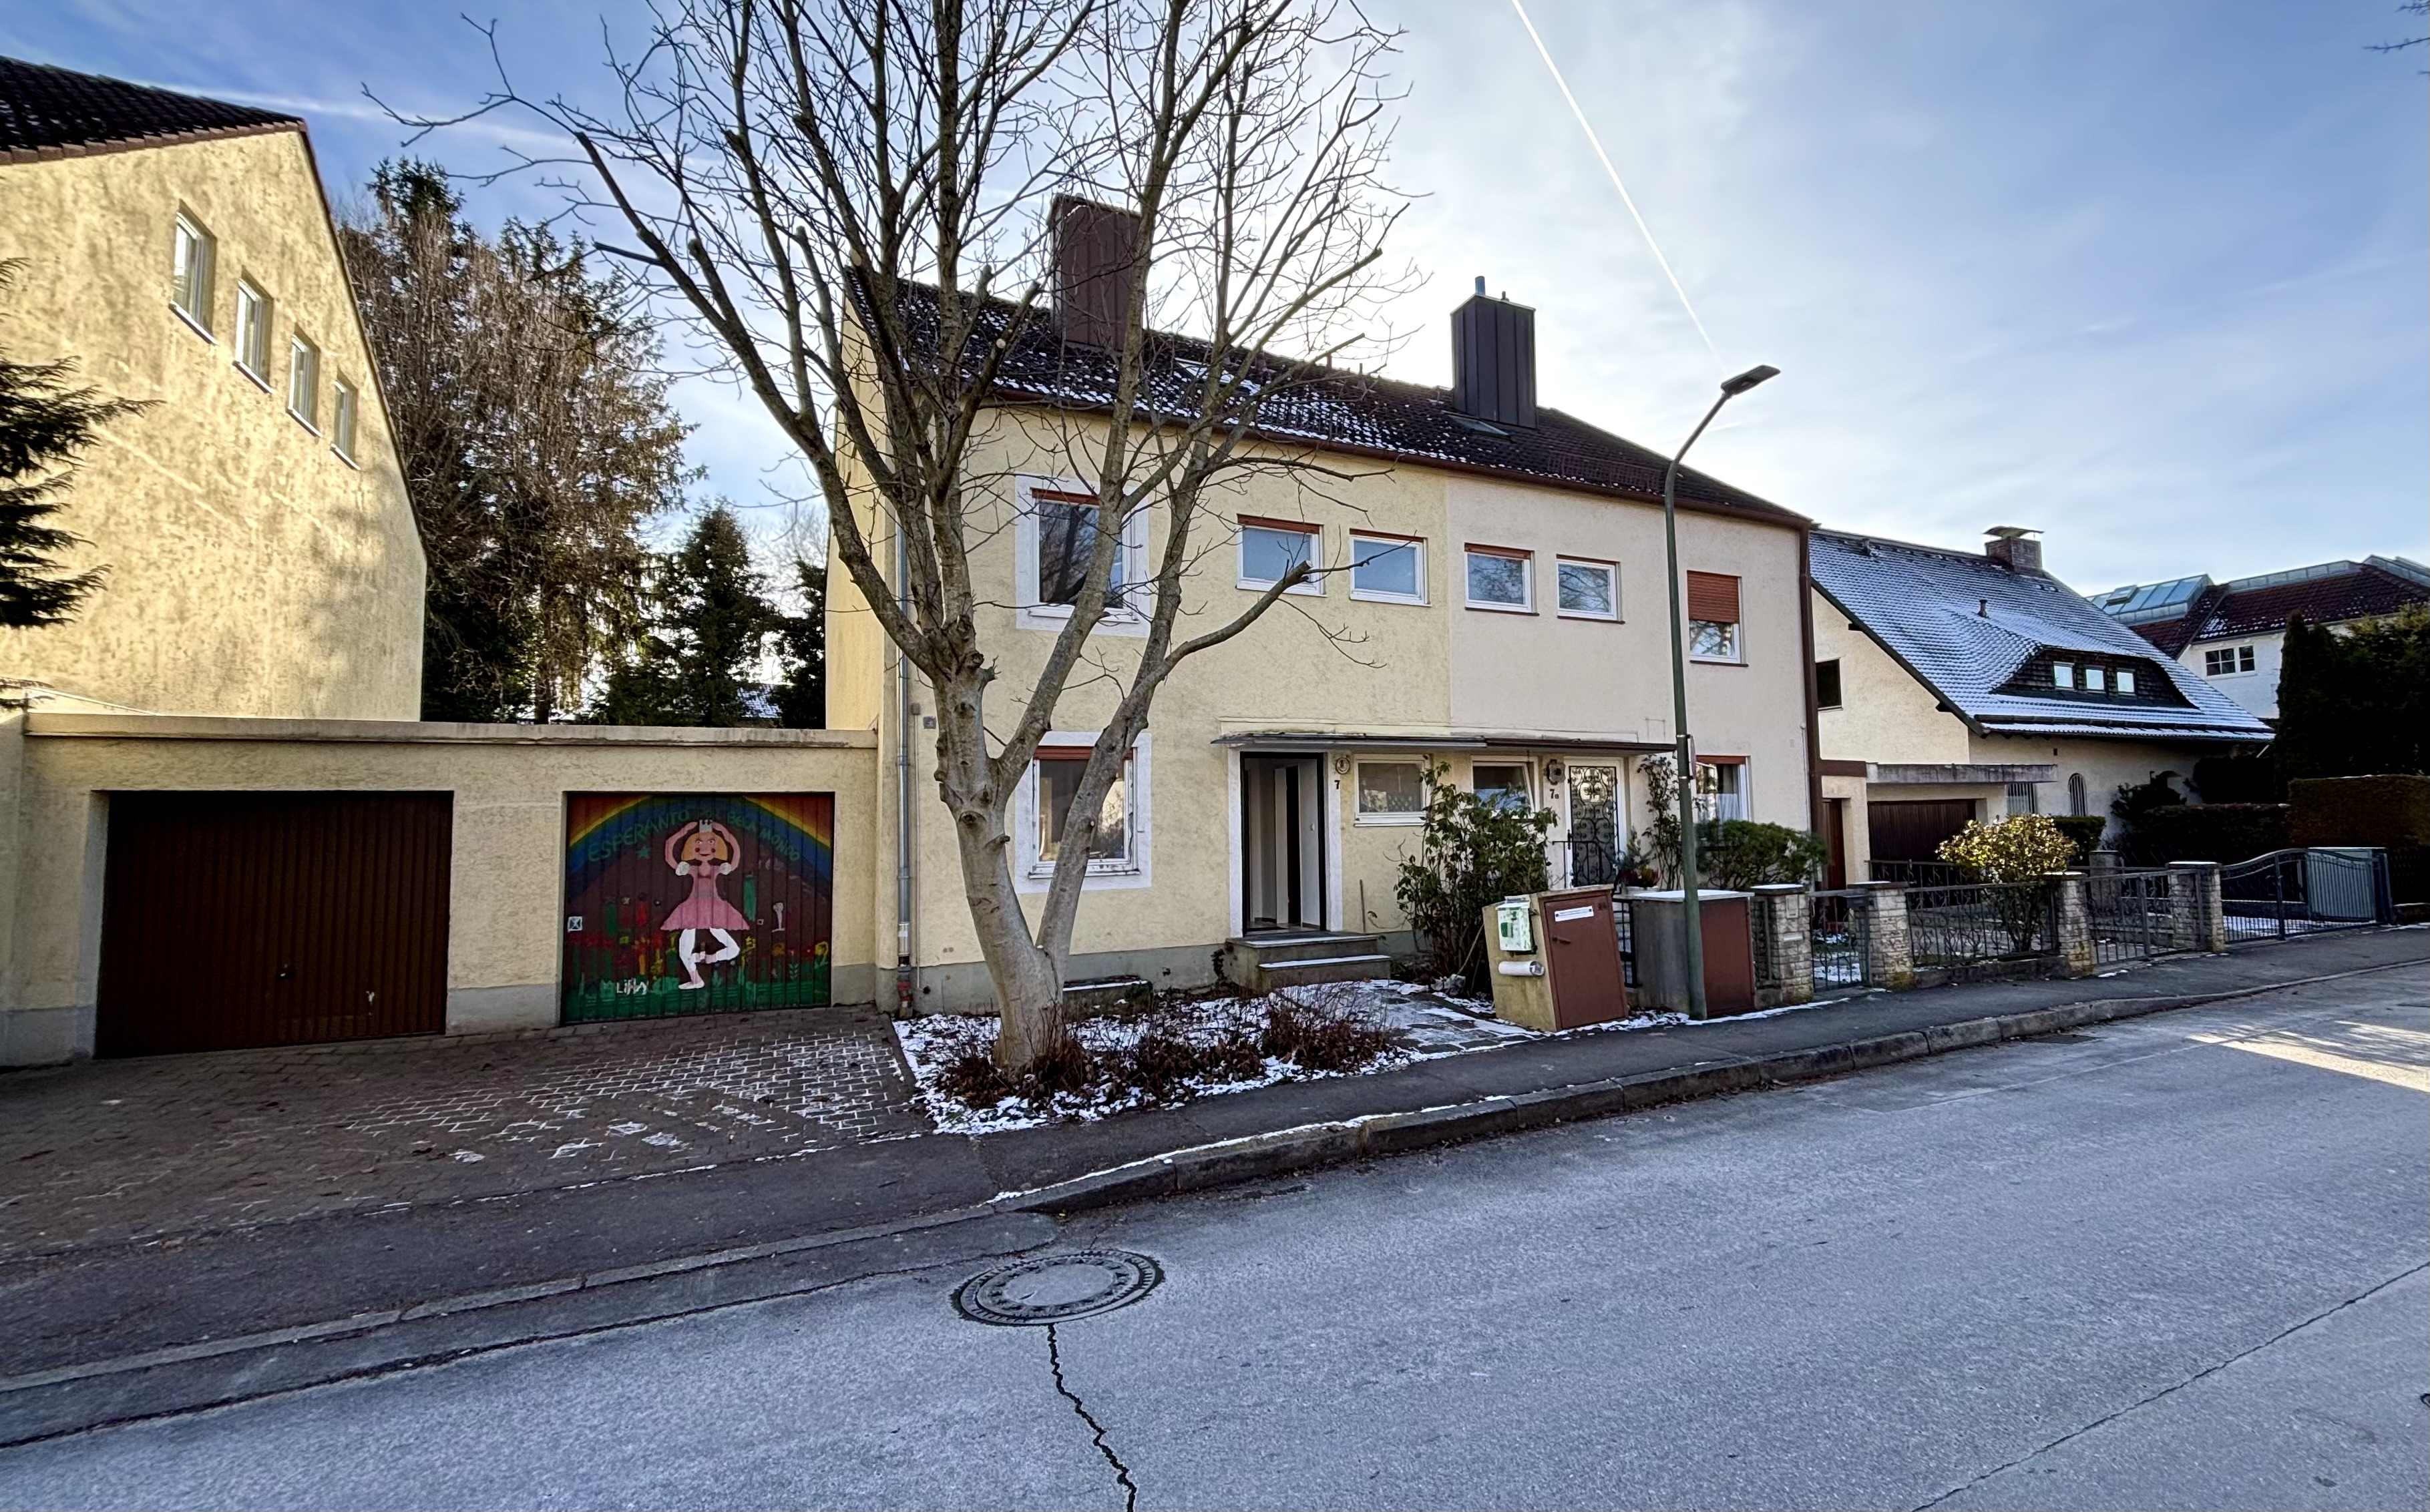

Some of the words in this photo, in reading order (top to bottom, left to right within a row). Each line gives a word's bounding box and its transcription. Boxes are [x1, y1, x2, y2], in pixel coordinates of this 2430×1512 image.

[1334, 780, 1340, 790] 7
[1549, 788, 1559, 799] 7a
[588, 809, 690, 862] ESPERANTO
[727, 811, 757, 832] BELA
[760, 827, 800, 862] MONDO
